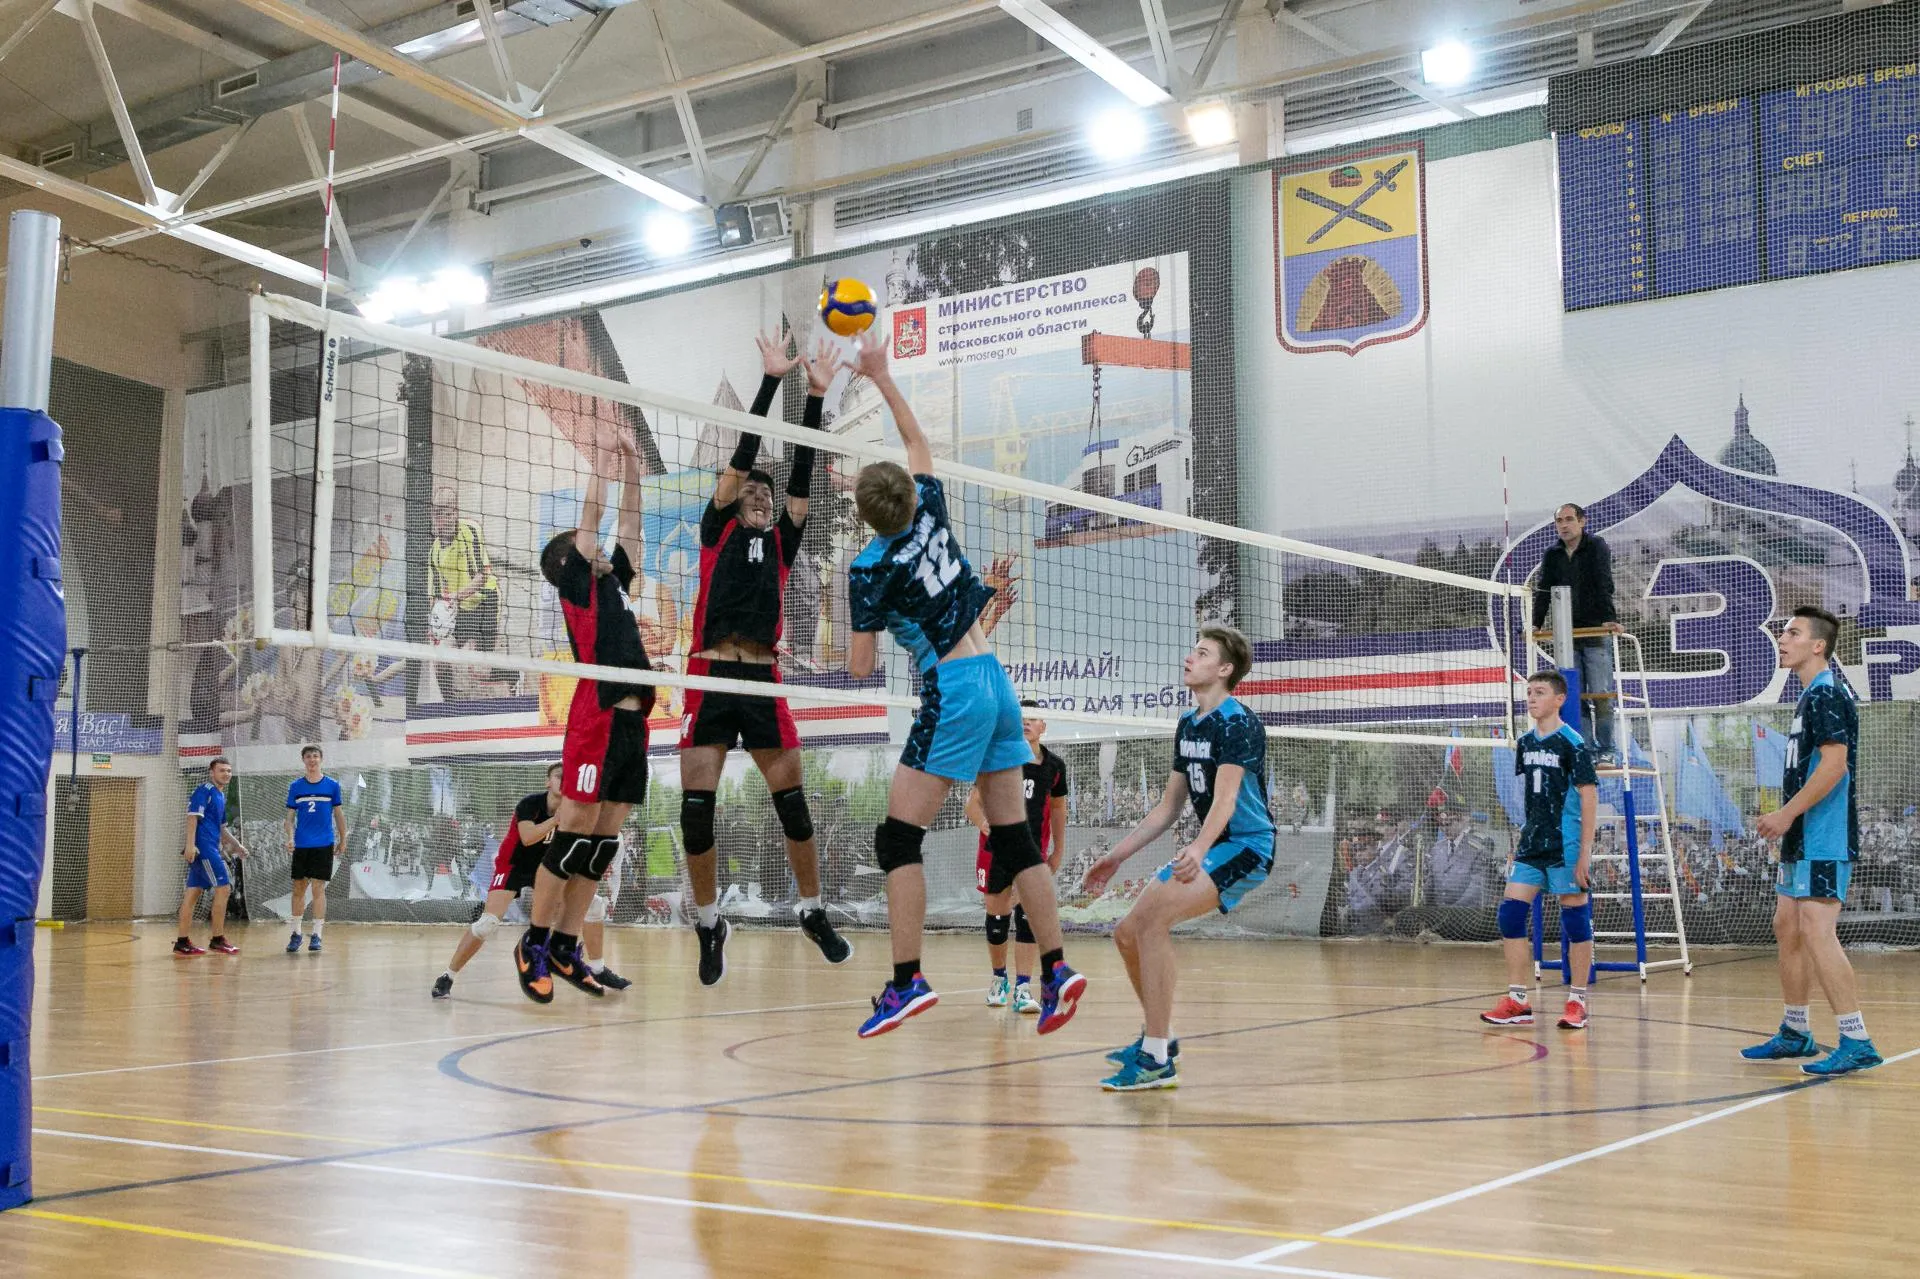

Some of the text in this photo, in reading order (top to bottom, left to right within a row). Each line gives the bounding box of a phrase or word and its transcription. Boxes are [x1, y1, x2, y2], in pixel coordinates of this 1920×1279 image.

[1796, 63, 1920, 97] ИГРОВОЕ ВРЕМ
[1783, 151, 1825, 170] СЧЕТ
[1842, 206, 1899, 224] ПЕРИОД
[938, 276, 1087, 318] МИНИСТЕРСТВО
[937, 292, 1127, 336] строительного комплекса
[938, 316, 1088, 353] Московской области
[938, 346, 1018, 367] www.mosreg.ru
[915, 527, 961, 598] 12
[1002, 651, 1121, 684] РИНИМАЙ!
[1082, 694, 1124, 713] для
[1130, 684, 1193, 710] тебя!
[77, 713, 126, 735] Вас!
[576, 763, 597, 794] 10
[1022, 779, 1035, 799] 13
[1186, 762, 1206, 794] 15
[1533, 767, 1542, 793] 1
[308, 801, 316, 813] 2
[493, 872, 505, 886] 11
